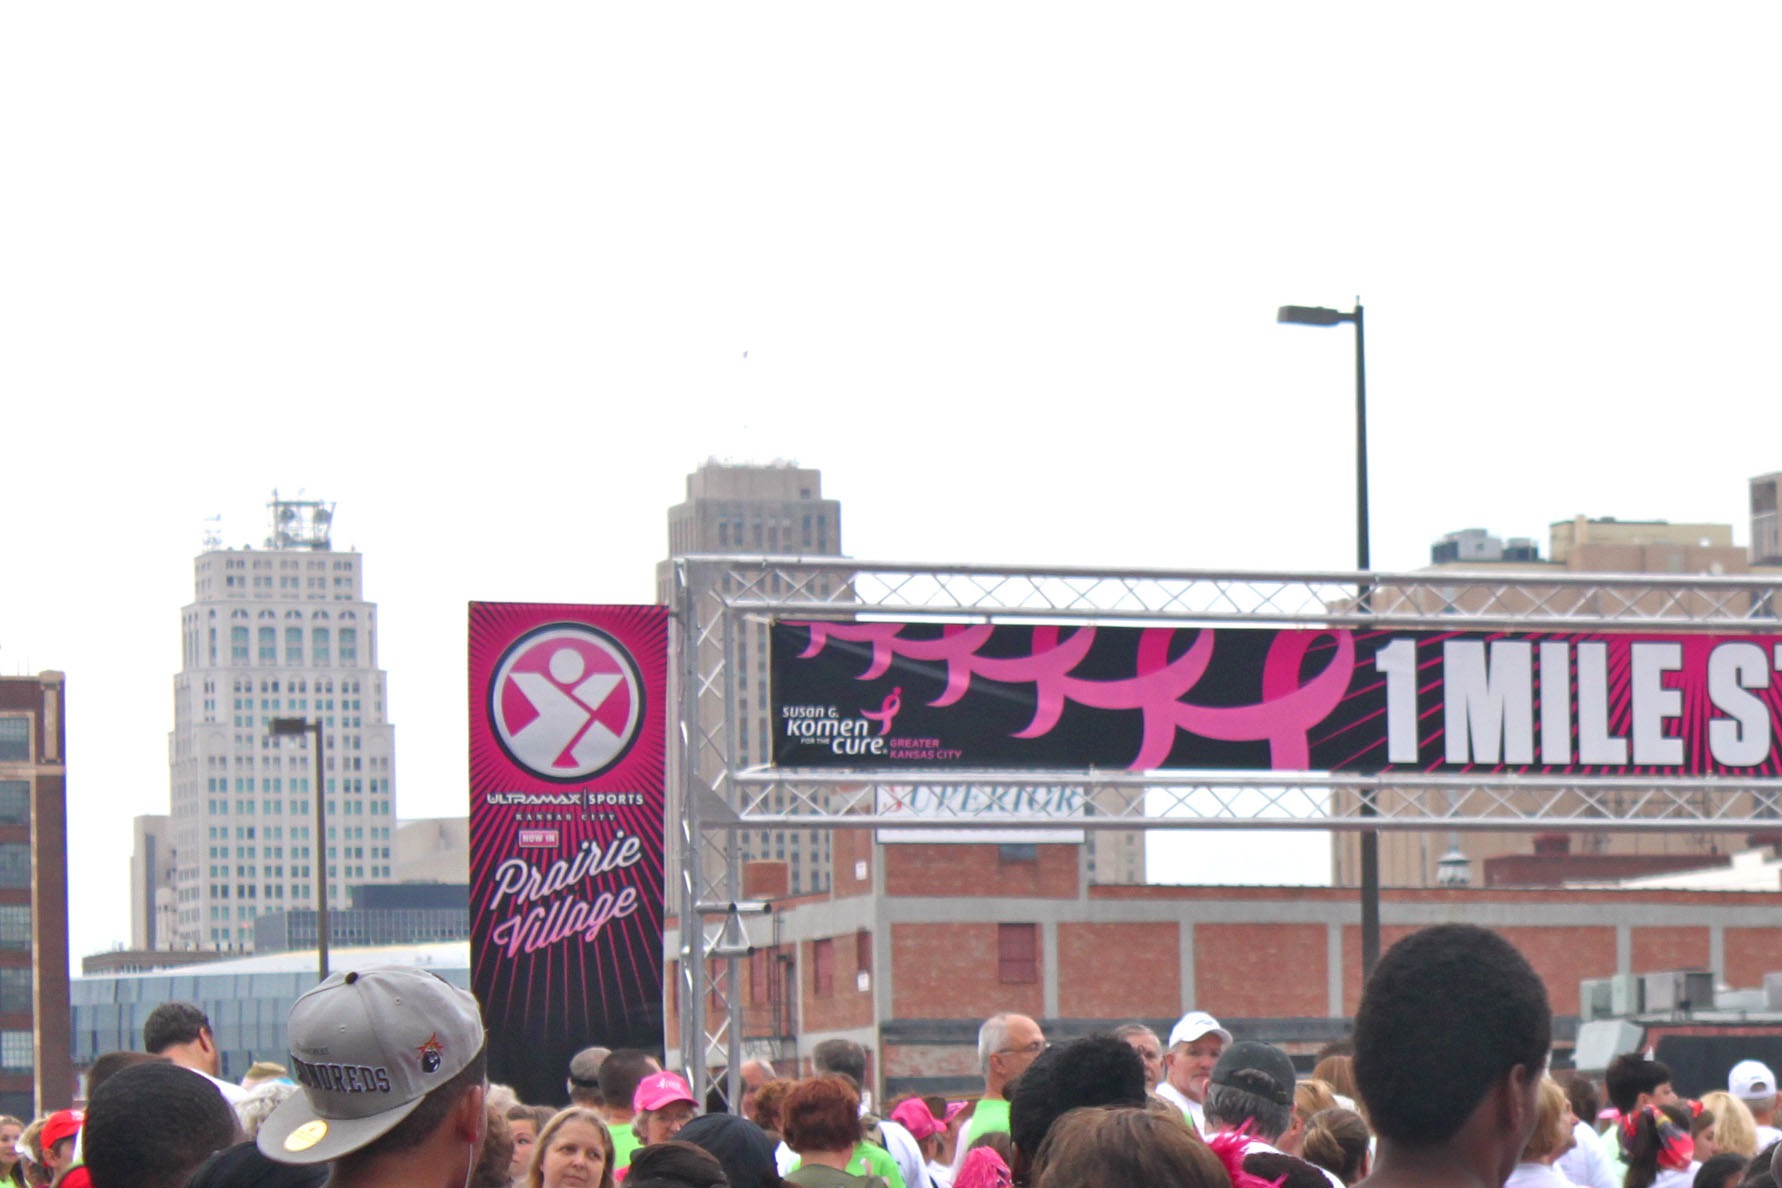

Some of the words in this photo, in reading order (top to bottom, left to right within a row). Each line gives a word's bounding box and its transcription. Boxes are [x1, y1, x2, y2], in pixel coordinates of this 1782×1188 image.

[1375, 639, 1418, 764] 1
[1443, 640, 1685, 766] MILE
[889, 738, 940, 748] GREATER
[889, 750, 935, 759] KANSAS
[936, 750, 962, 759] CITY
[486, 793, 582, 805] ULTRAMAX
[588, 793, 644, 805] SPORTS
[490, 829, 643, 910] Prairie
[493, 886, 639, 958] Village
